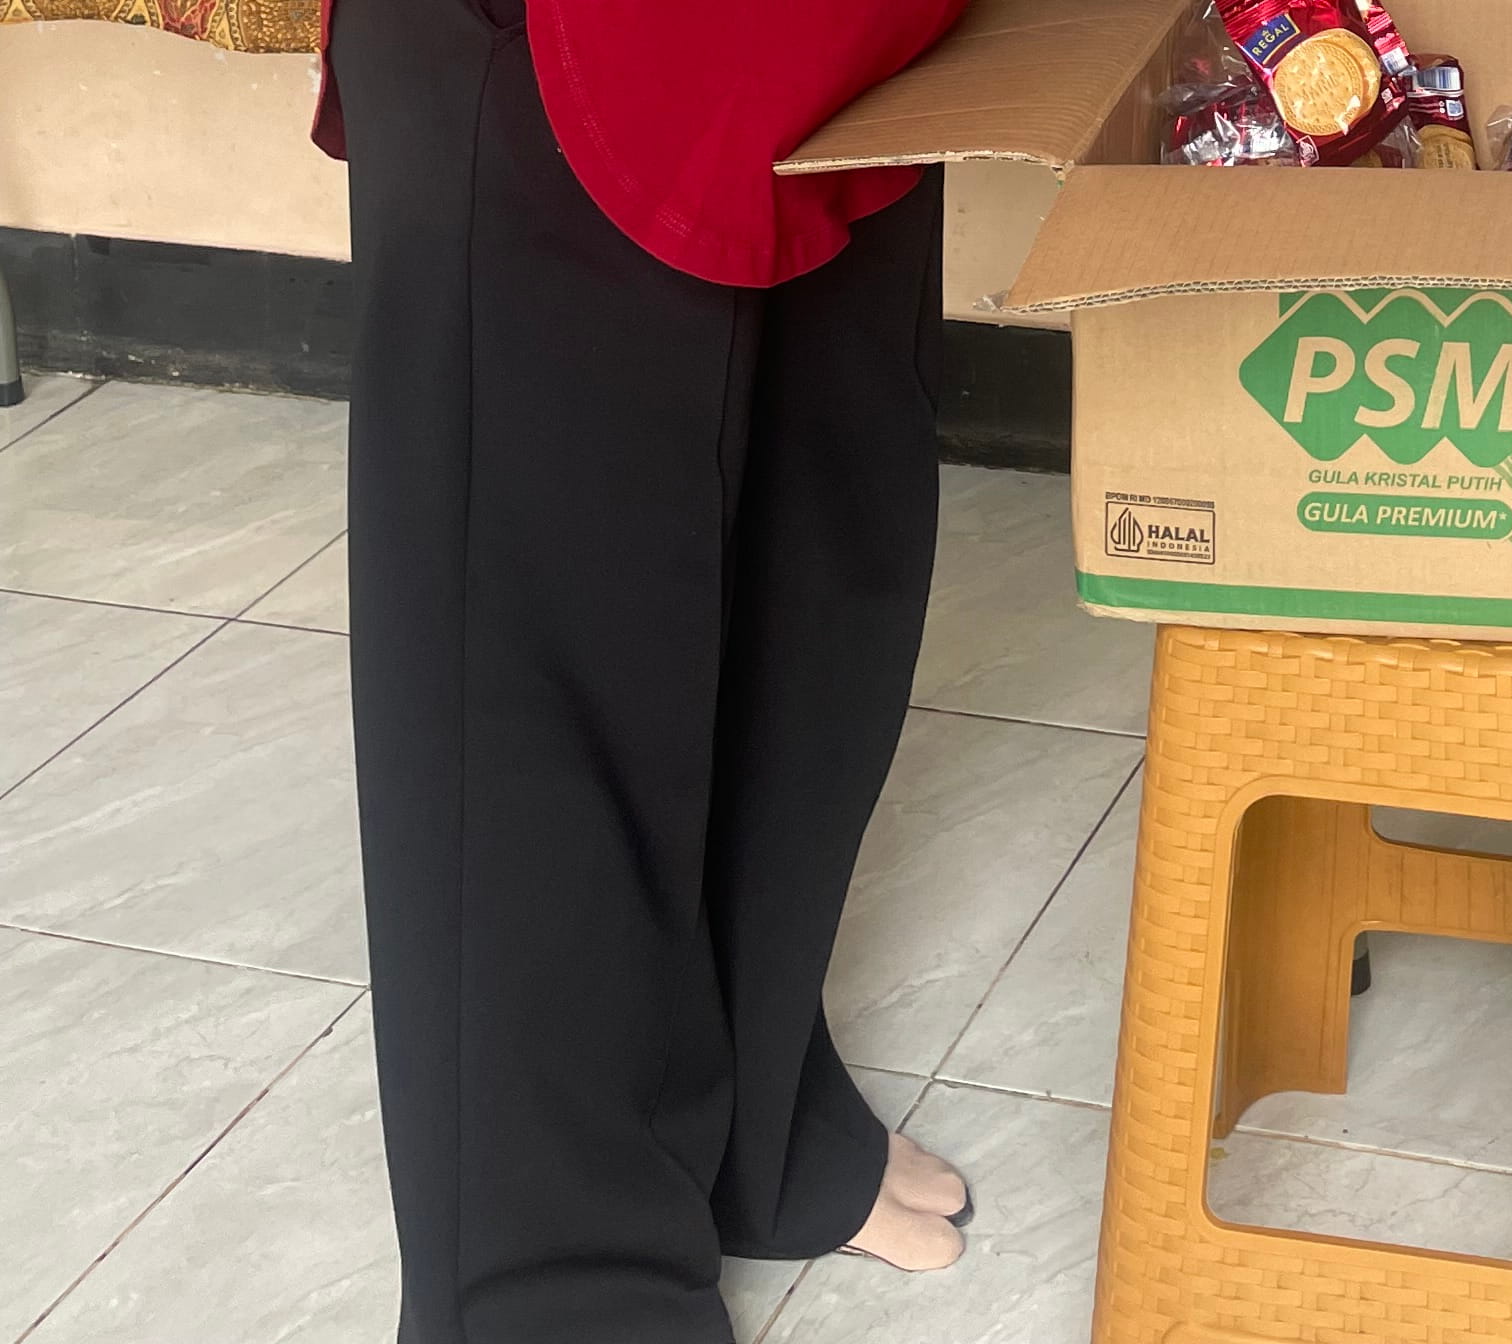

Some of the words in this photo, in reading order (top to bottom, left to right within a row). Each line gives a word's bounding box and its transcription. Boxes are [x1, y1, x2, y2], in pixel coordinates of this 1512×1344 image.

[1251, 23, 1291, 57] REGAL
[1308, 469, 1360, 485] GULA
[1364, 472, 1442, 489] KRISTAL
[1447, 475, 1503, 492] PUTIH
[1304, 502, 1369, 523] GULA
[1148, 524, 1211, 543] HALAL
[1147, 541, 1210, 553] INDONESIA
